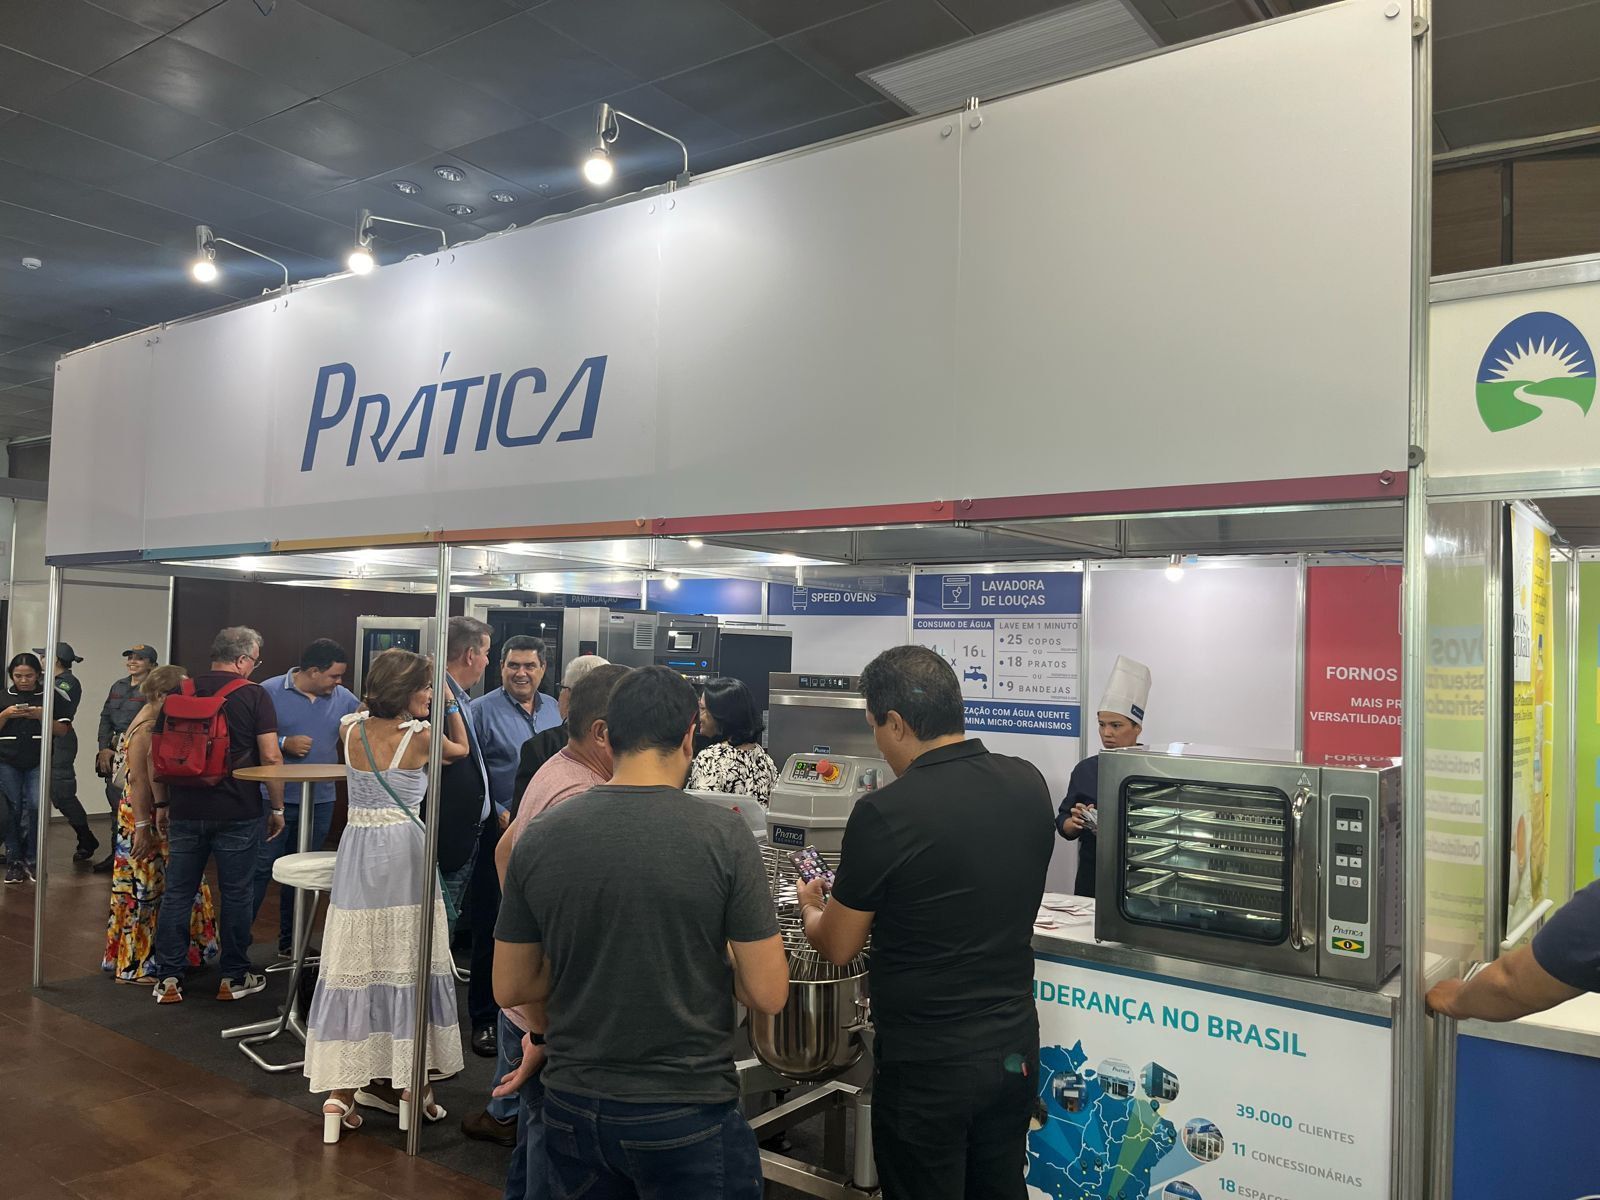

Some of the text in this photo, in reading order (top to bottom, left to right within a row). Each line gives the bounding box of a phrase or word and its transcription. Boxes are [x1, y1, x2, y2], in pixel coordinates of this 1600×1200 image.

[982, 579, 1045, 591] LAVADORA
[811, 592, 877, 602] SPEED OVENS
[981, 594, 1046, 609] DE LOUÇAS
[969, 619, 992, 628] ÁGUA
[999, 622, 1078, 630] LAVE EM 1 MINUTO
[1007, 634, 1062, 646] 25 COPOS
[1007, 656, 1067, 668] 18 PRATOS
[1326, 666, 1398, 681] FORNOS
[1006, 681, 1071, 694] 9 BANDEJAS
[1351, 697, 1383, 708] MAIS
[992, 708, 1011, 716] COM
[1012, 707, 1035, 718] ÁGUA
[1037, 710, 1070, 720] QUENTE
[1310, 711, 1402, 726] VERSATILIDADE
[964, 717, 1072, 730] MINA MICRO-ORGANISMOS
[1162, 1005, 1199, 1033] NO
[1207, 1014, 1307, 1057] BRASIL
[1236, 1103, 1355, 1145] 39.000 CLIENTES
[1231, 1142, 1363, 1188] 11 CONCESSIONÁRIAS
[1218, 1177, 1236, 1193] 18
